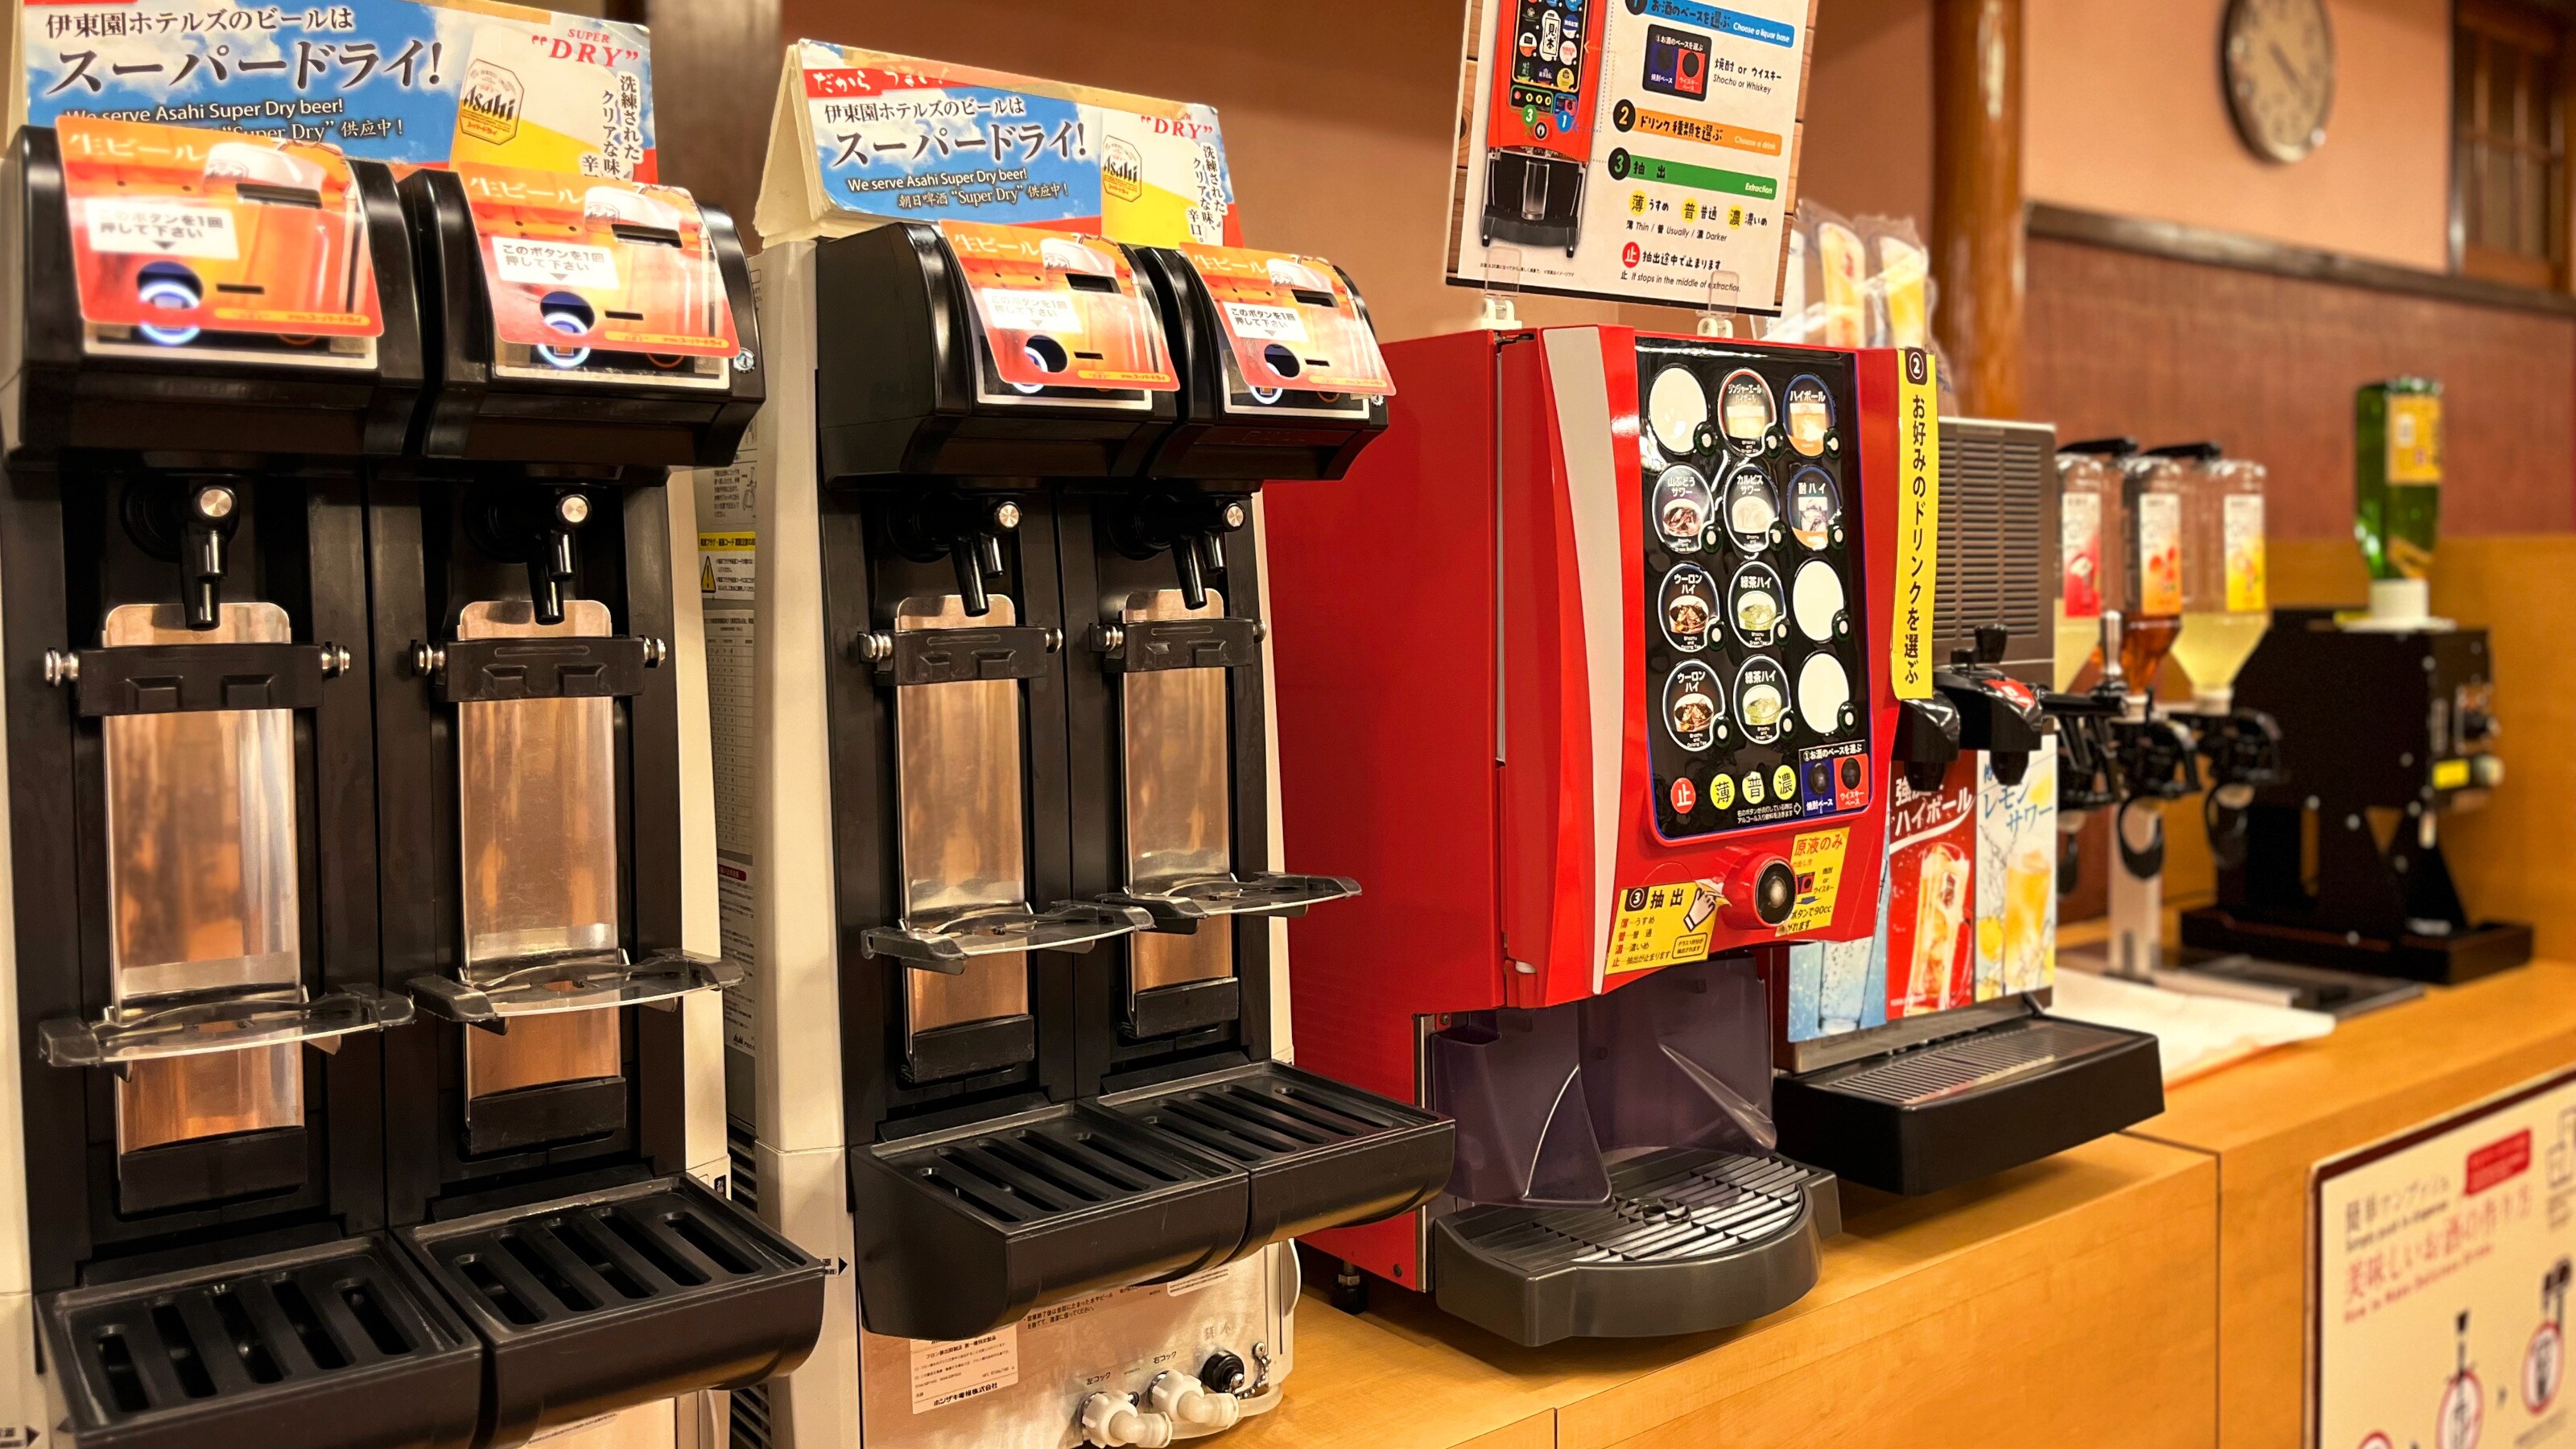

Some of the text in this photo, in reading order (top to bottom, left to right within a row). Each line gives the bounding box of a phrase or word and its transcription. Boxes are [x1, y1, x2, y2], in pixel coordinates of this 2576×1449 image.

[46, 8, 352, 38] 伊東園ホテルズのビールは
[1651, 0, 1731, 30] お酒のベースを選ぶ
[1732, 22, 1755, 35] Choose
[1776, 31, 1790, 43] base
[568, 28, 611, 43] SUPER
[47, 41, 441, 95] スーパードライ!
[1714, 57, 1782, 81] 焼酎 or ウイスキー
[812, 70, 871, 93] だから
[1712, 73, 1772, 95] Shochu or Whiskey
[155, 104, 204, 122] Asahi
[209, 101, 262, 121] Super
[266, 100, 295, 118] Dry
[300, 98, 344, 114] beer!
[463, 85, 516, 122] Asahi
[824, 96, 1025, 125] 伊東園ホテルズのビールは
[619, 75, 641, 160] 洗練された
[1525, 108, 1534, 122] 3
[1562, 114, 1567, 128] 1
[1620, 105, 1629, 126] 2
[68, 133, 208, 163] 生ビール
[832, 120, 1087, 169] スーパードライ!
[581, 155, 600, 179] 辛
[1104, 155, 1138, 184] Asahi
[1614, 154, 1624, 173] 3
[1744, 182, 1773, 194] Extraction
[848, 167, 1027, 192] We serve Asahi Super Dry beer!
[1203, 145, 1226, 213] 洗練された
[469, 176, 585, 205] 生ビール
[898, 192, 948, 208] 朝日啤酒
[1649, 199, 1670, 213] うすめ
[1684, 202, 1695, 220] 普
[1700, 205, 1718, 221] 普通
[1744, 213, 1768, 226] 濃いめ
[1636, 221, 1649, 232] Thin
[1666, 225, 1690, 238] Usually
[1706, 231, 1728, 242] Darker
[502, 244, 605, 264] このボタンを1回
[954, 233, 1040, 256] 生ビール
[505, 256, 590, 272] 押して下さい
[1193, 254, 1268, 274] 生ビール
[1624, 245, 1721, 270] 止 抽出途中で止まります
[1620, 270, 1628, 280] 止
[1637, 273, 1655, 283] stops
[1656, 274, 1662, 283] in
[1664, 275, 1674, 285] the
[1675, 277, 1699, 288] middle
[1700, 278, 1707, 288] of
[1230, 308, 1296, 321] このボタンを1回
[1790, 390, 1827, 402] ハイボール
[1667, 476, 1696, 487] 山ぶどう
[1736, 474, 1764, 485] カルピス
[1740, 485, 1761, 495] サワー
[1671, 487, 1693, 497] サワー
[1905, 394, 1926, 684] お好みのドリンクを選ぶ
[1674, 573, 1703, 584] ウーロン
[1681, 584, 1696, 595] ハイ
[1740, 576, 1773, 589] 緑茶ハイ
[1677, 671, 1706, 684] ウーロン
[1685, 681, 1699, 693] ハイ
[1744, 670, 1777, 684] 緑茶ハイ
[1715, 780, 1732, 804] 薄
[1748, 776, 1762, 799] 普
[1777, 772, 1793, 795] 濃
[1675, 784, 1692, 807] 止
[1839, 790, 1865, 801] ウイスキー
[1845, 798, 1860, 806] ベース
[1894, 786, 1972, 836] ハイボール
[2005, 803, 2054, 838] サワー
[1794, 833, 1843, 857] 原液のみ
[1649, 888, 1684, 910] 抽出
[1153, 1351, 1177, 1364] 右コック
[1086, 1372, 1111, 1385] 左コック
